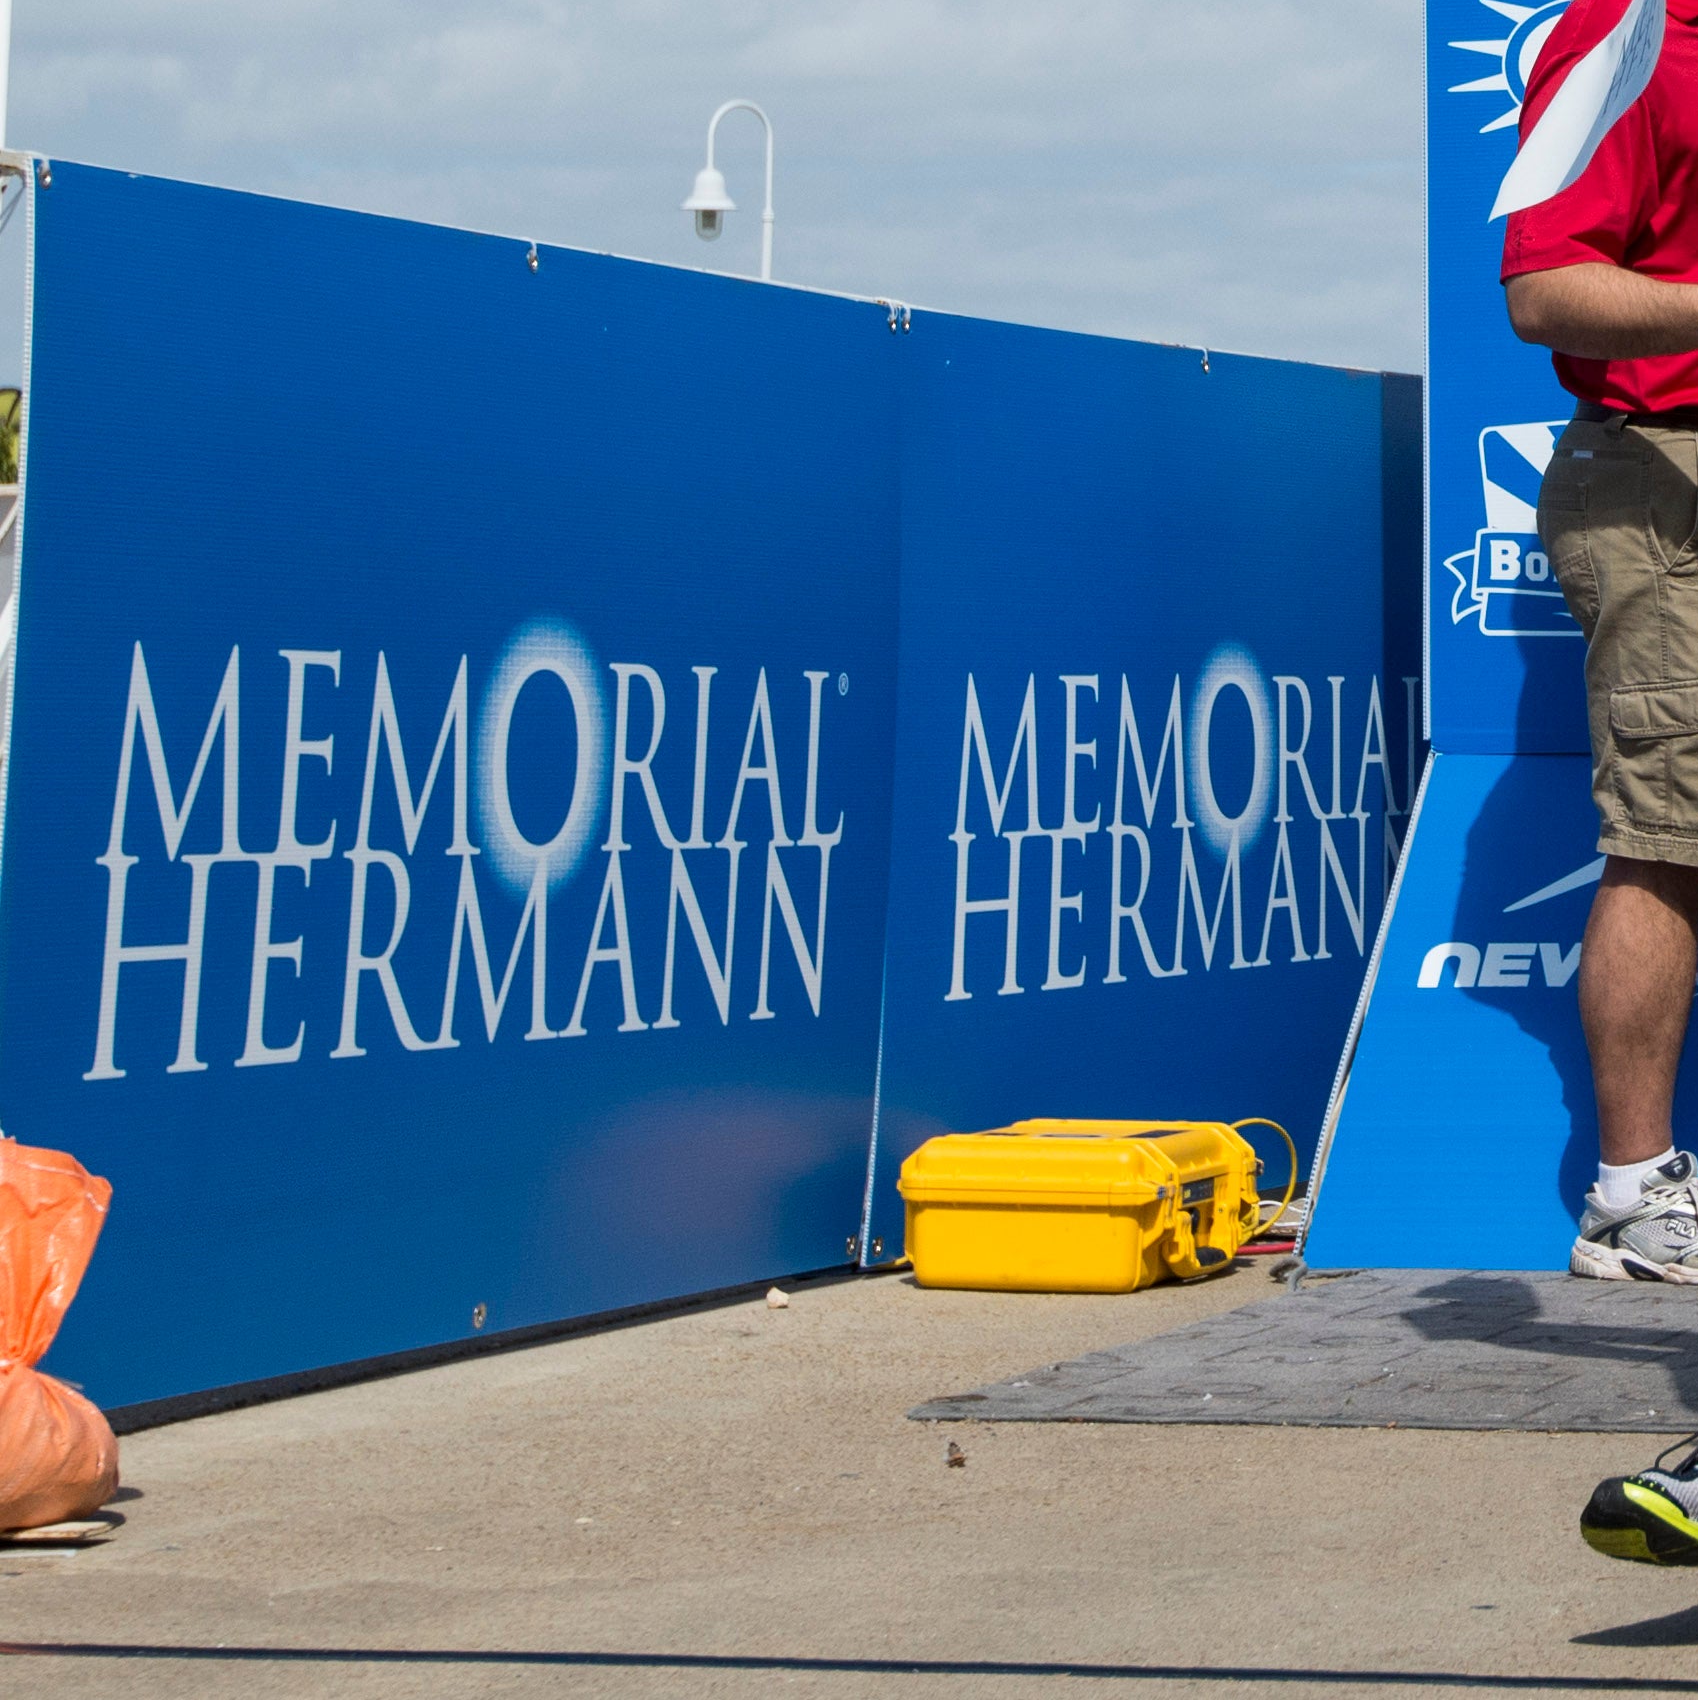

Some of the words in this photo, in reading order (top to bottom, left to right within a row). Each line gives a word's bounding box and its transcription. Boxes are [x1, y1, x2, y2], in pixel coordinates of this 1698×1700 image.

[1489, 540, 1556, 581] BO
[103, 638, 847, 863] MEMORIAL
[82, 843, 842, 1081] HERMANN
[1666, 1218, 1697, 1239] FILA
